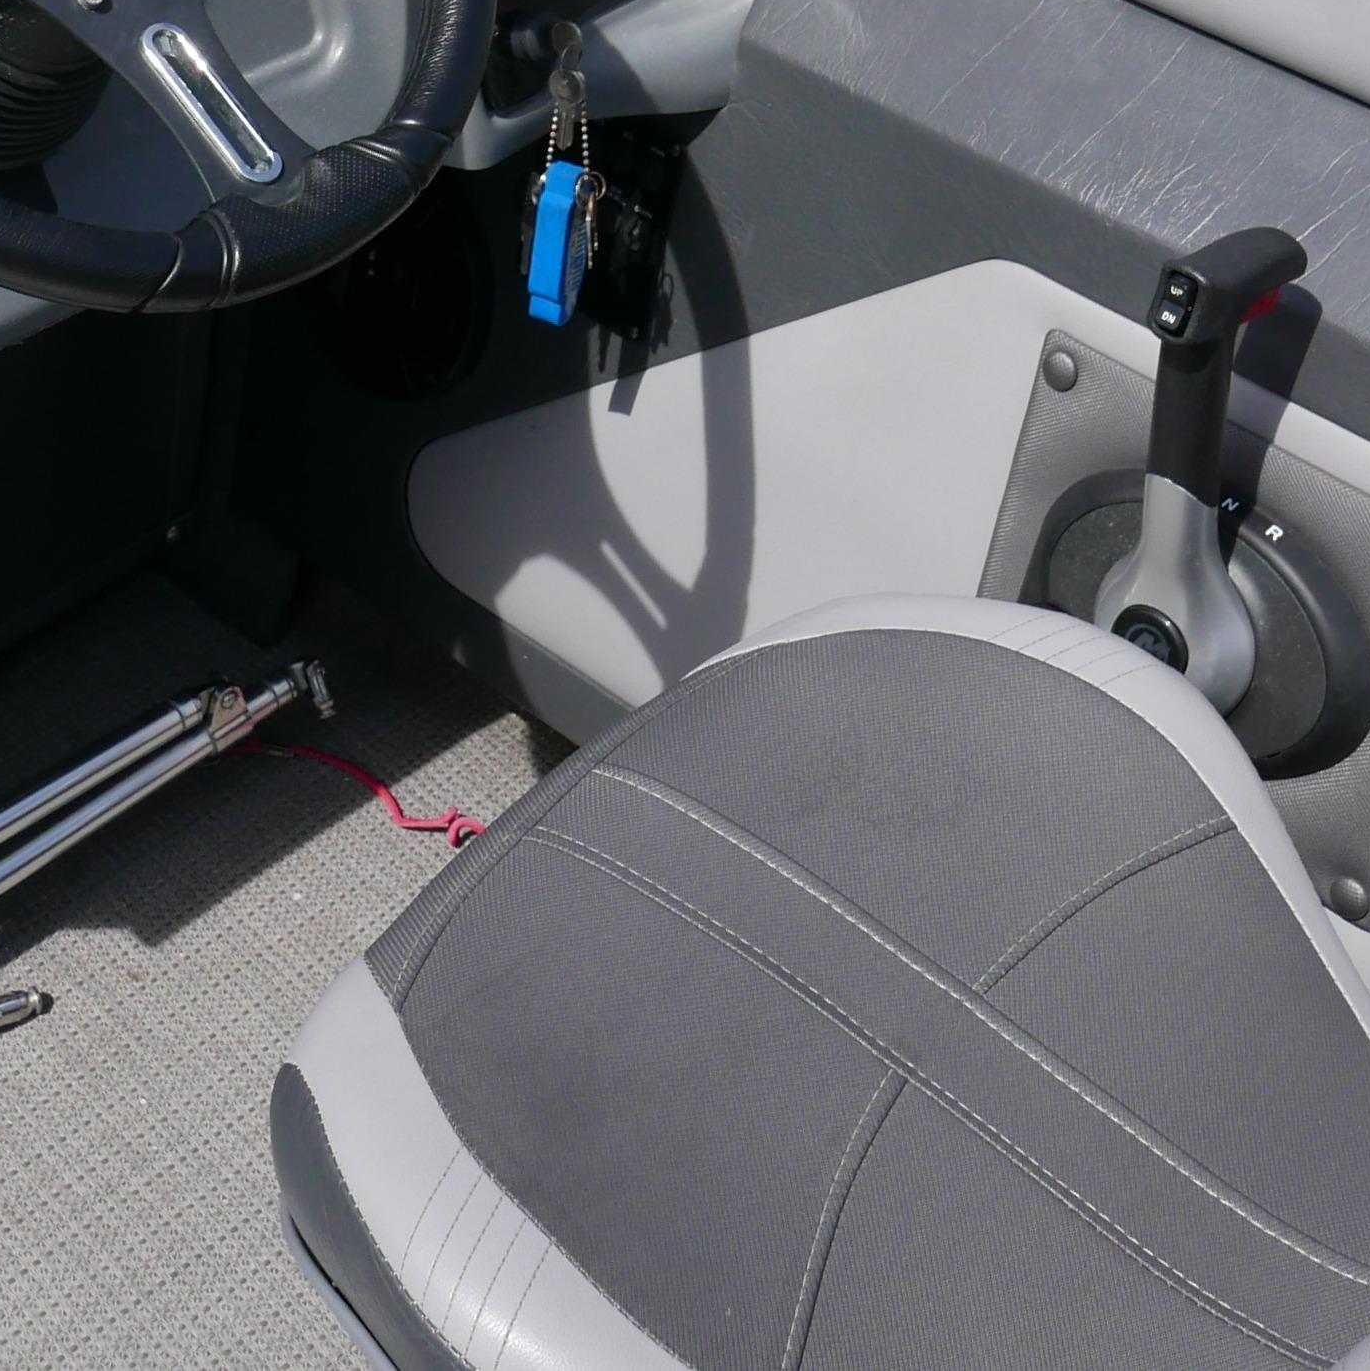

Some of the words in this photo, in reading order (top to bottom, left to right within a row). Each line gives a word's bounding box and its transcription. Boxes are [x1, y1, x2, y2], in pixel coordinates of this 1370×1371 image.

[1170, 285, 1184, 297] UP
[1161, 311, 1177, 324] DN
[1221, 497, 1240, 511] N
[1265, 524, 1284, 541] R
